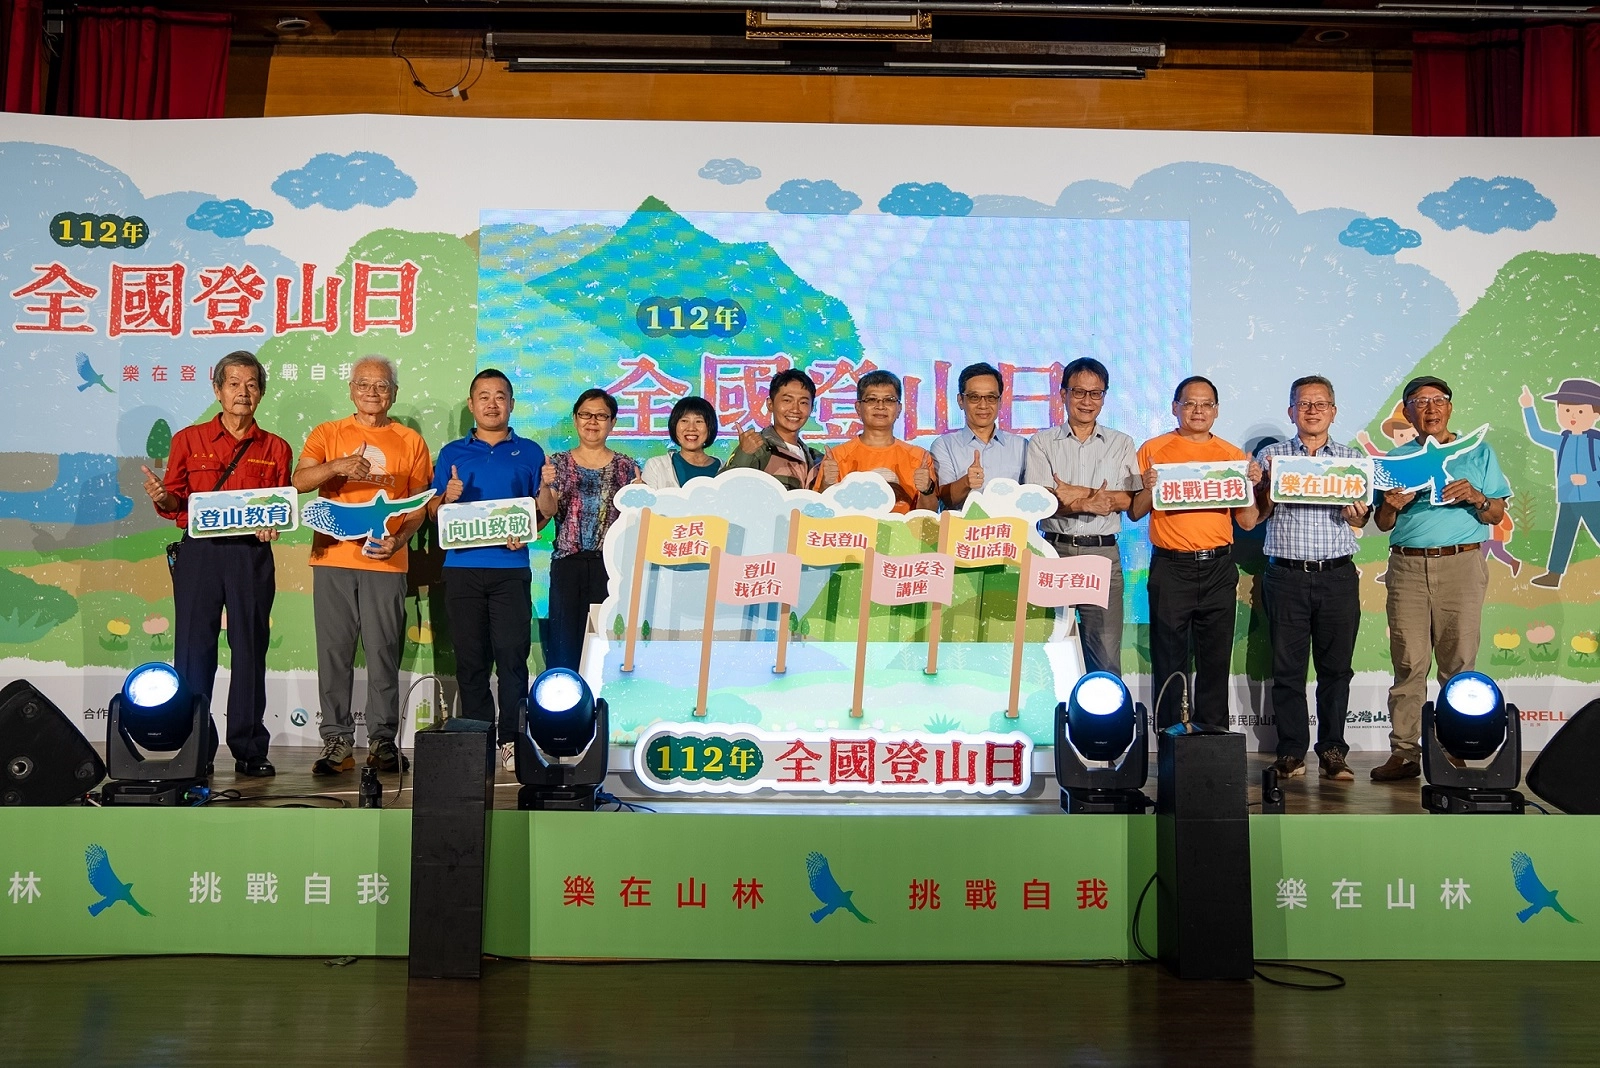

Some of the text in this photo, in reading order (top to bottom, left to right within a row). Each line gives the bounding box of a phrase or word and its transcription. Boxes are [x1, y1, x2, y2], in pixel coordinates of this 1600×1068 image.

[57, 218, 144, 244] 112年
[13, 262, 419, 336] 全國登山日
[645, 304, 742, 332] 112年
[605, 354, 1068, 440] 全國登山日
[1162, 479, 1244, 501] 挑戰自我
[1281, 473, 1364, 496] 樂在山林
[200, 504, 288, 529] 登山教育
[448, 516, 529, 541] 向山致敬
[673, 521, 704, 539] 全民
[807, 531, 868, 549] 全民登山
[965, 523, 1011, 541] 北中南
[662, 539, 709, 557] 樂健行
[956, 541, 1017, 560] 登山活動
[743, 560, 776, 578] 登山
[882, 560, 945, 579] 登山安全
[1037, 571, 1101, 590] 親子登山
[734, 578, 782, 598] 我在行
[896, 579, 928, 598] 講座
[1346, 710, 1391, 723] 台灣山
[656, 744, 756, 774] 112年
[774, 737, 1027, 786] 全國登山日
[8, 871, 41, 904] 林
[189, 871, 390, 905] 挑戰自我
[563, 875, 764, 909] 樂在山林
[909, 878, 1108, 911] 挑戰自我
[1276, 877, 1472, 910] 樂在山林
